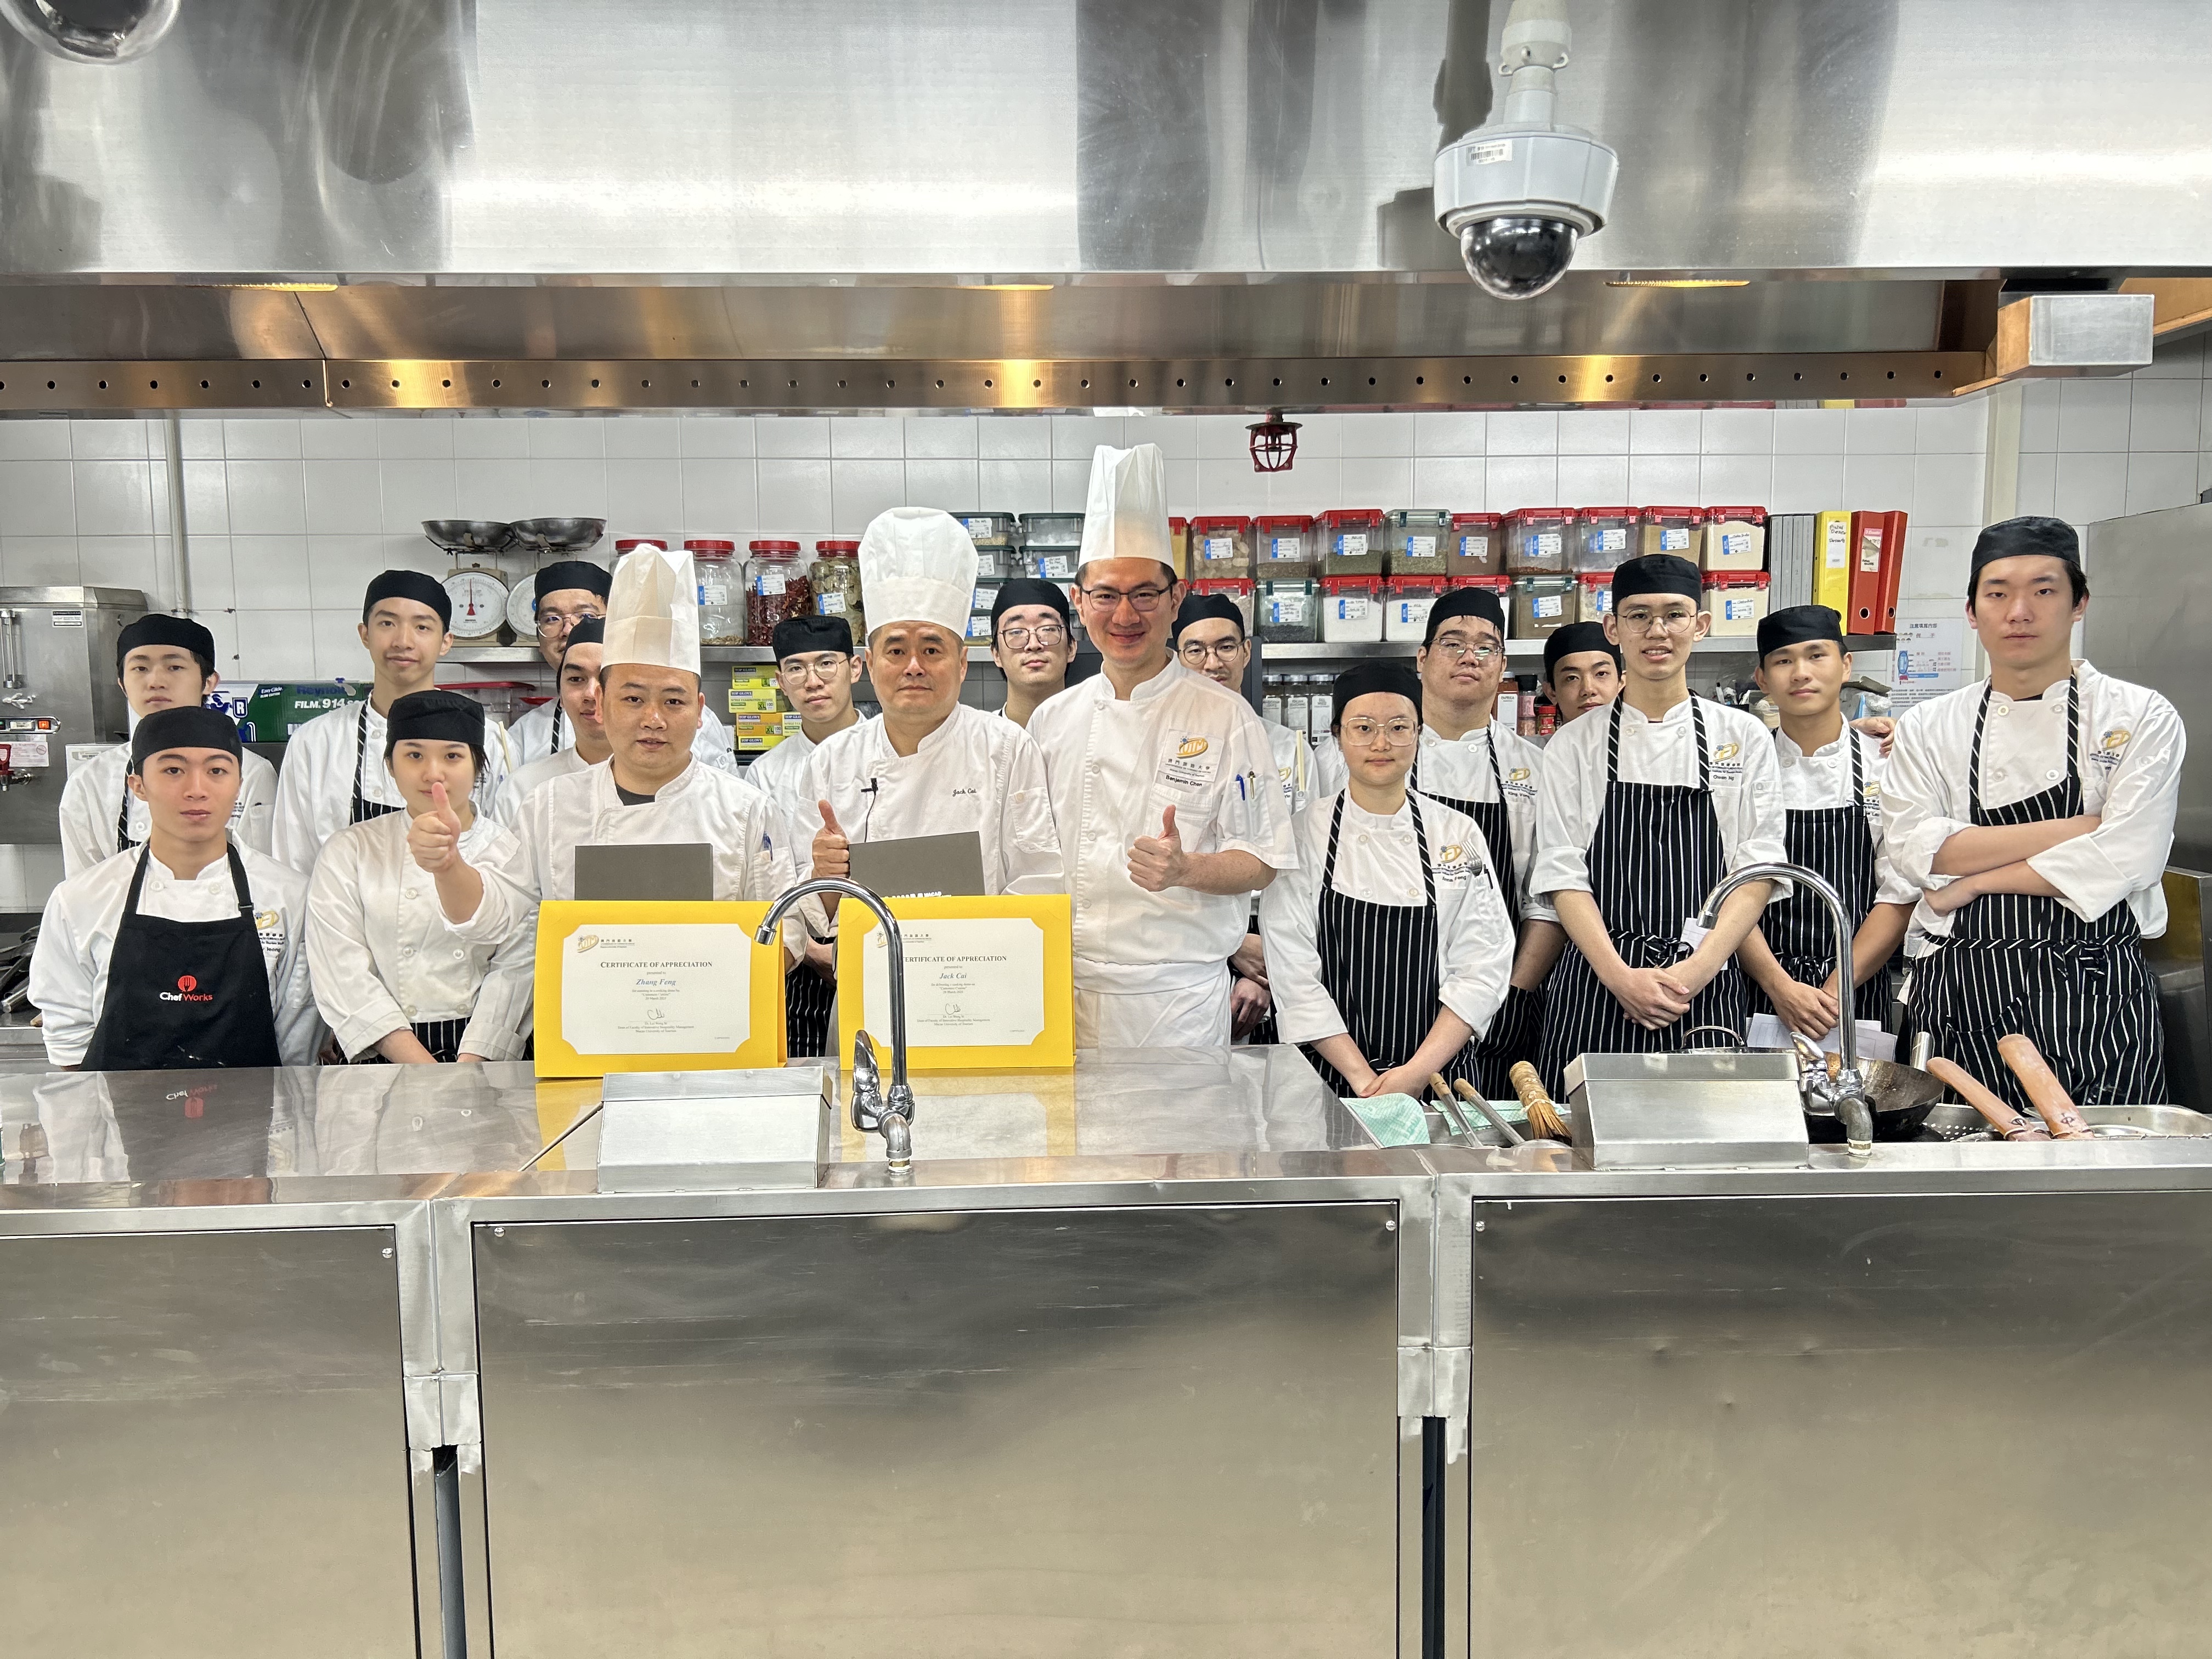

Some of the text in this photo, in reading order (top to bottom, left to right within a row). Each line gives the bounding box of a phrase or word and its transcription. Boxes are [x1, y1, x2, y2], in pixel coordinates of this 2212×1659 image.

[323, 698, 345, 709] 914
[1166, 775, 1189, 785] Benjamin
[160, 992, 182, 1001] Chef
